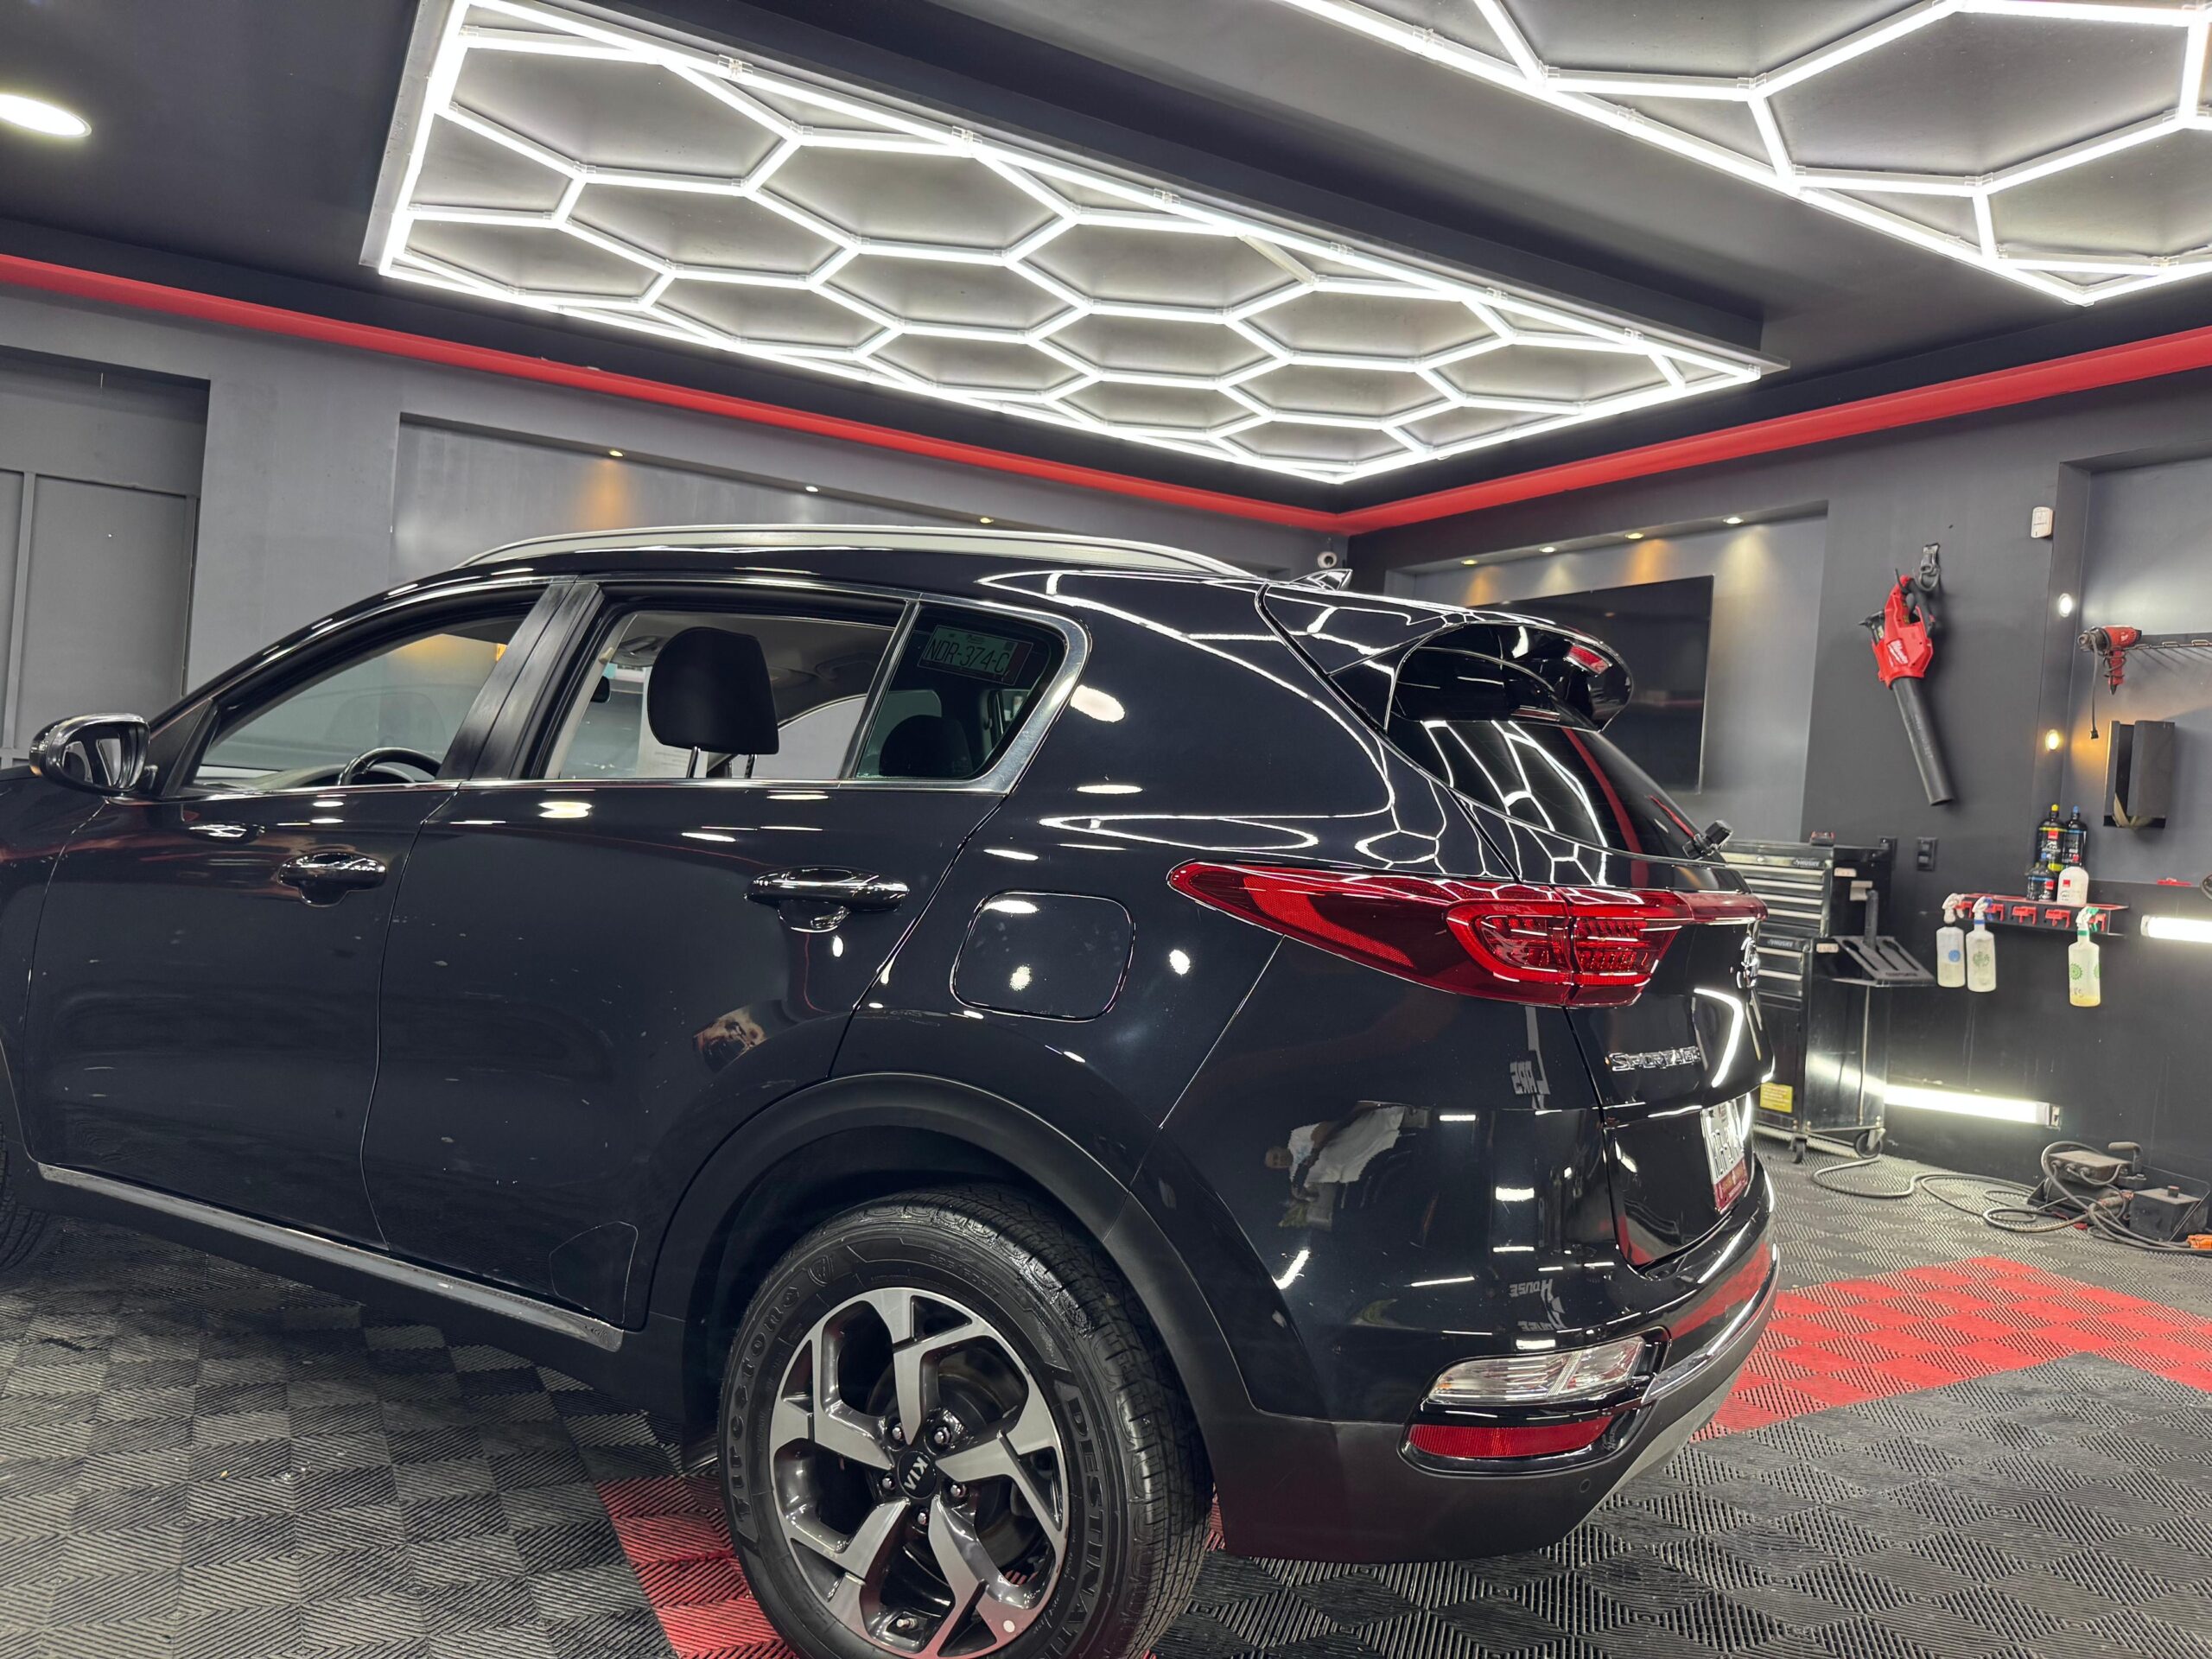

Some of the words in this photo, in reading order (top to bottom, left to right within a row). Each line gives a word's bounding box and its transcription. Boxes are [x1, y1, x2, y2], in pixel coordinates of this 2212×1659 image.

[925, 639, 1010, 673] NDR-374-C
[1609, 1046, 1701, 1071] SPORTAGE
[903, 1456, 929, 1491] KIA
[1045, 1397, 1103, 1659] DESTINATI
